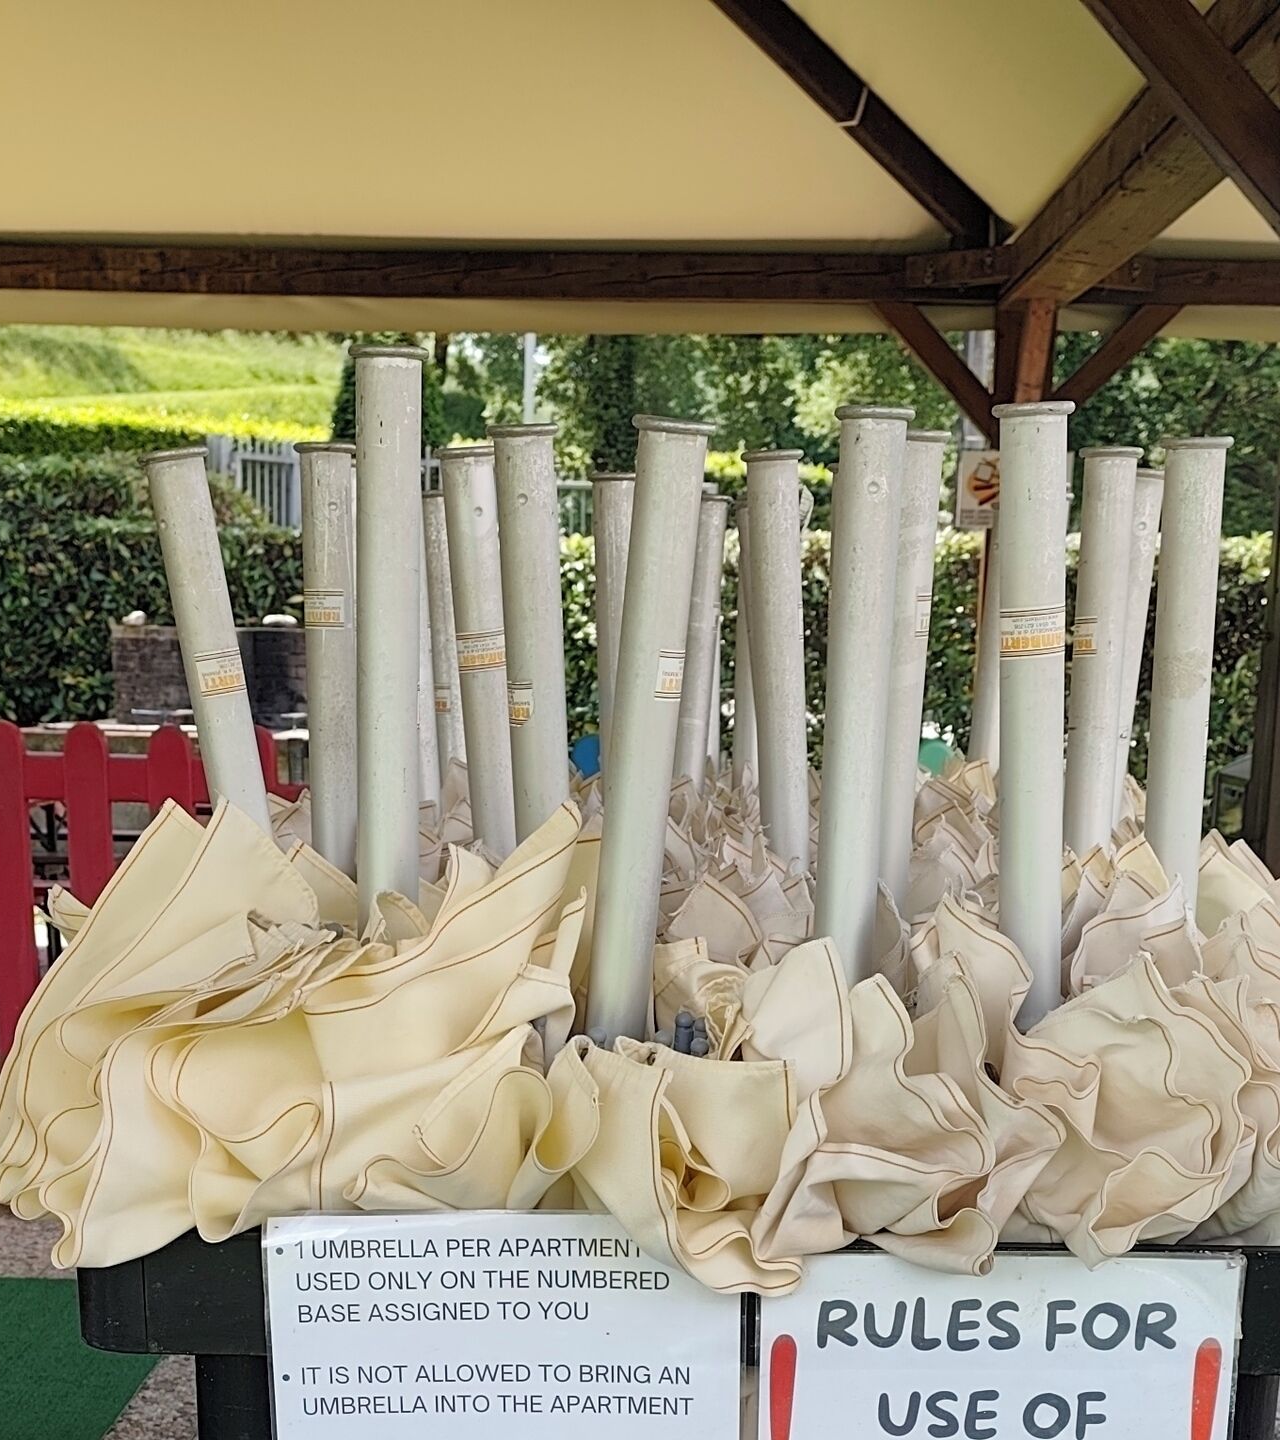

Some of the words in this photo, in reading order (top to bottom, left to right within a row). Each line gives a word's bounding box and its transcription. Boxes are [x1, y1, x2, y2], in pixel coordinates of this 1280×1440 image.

[293, 1240, 304, 1260] 1
[311, 1238, 440, 1260] UMBRELLA
[446, 1238, 491, 1258] PER
[295, 1271, 361, 1292] USED
[367, 1270, 433, 1291] ONLY
[439, 1270, 476, 1290] ON
[482, 1269, 530, 1289] THE
[537, 1269, 670, 1291] NUMBERED
[297, 1303, 362, 1324] BASE
[367, 1301, 490, 1323] ASSIGNED
[496, 1301, 531, 1321] TO
[537, 1300, 589, 1321] YOU
[816, 1296, 1021, 1352] RULES
[1045, 1299, 1178, 1352] FOR
[301, 1366, 322, 1386] IT
[328, 1365, 350, 1385] IS
[357, 1364, 409, 1385] NOT
[414, 1363, 531, 1383] ALLOWED
[537, 1363, 572, 1383] TO
[579, 1364, 651, 1385] BRING
[657, 1365, 690, 1386] AN
[302, 1395, 428, 1416] UMBRELLA
[434, 1394, 490, 1414] INTO
[496, 1394, 544, 1414] THE
[549, 1394, 695, 1416] APARTMENT
[877, 1389, 1000, 1440] USE
